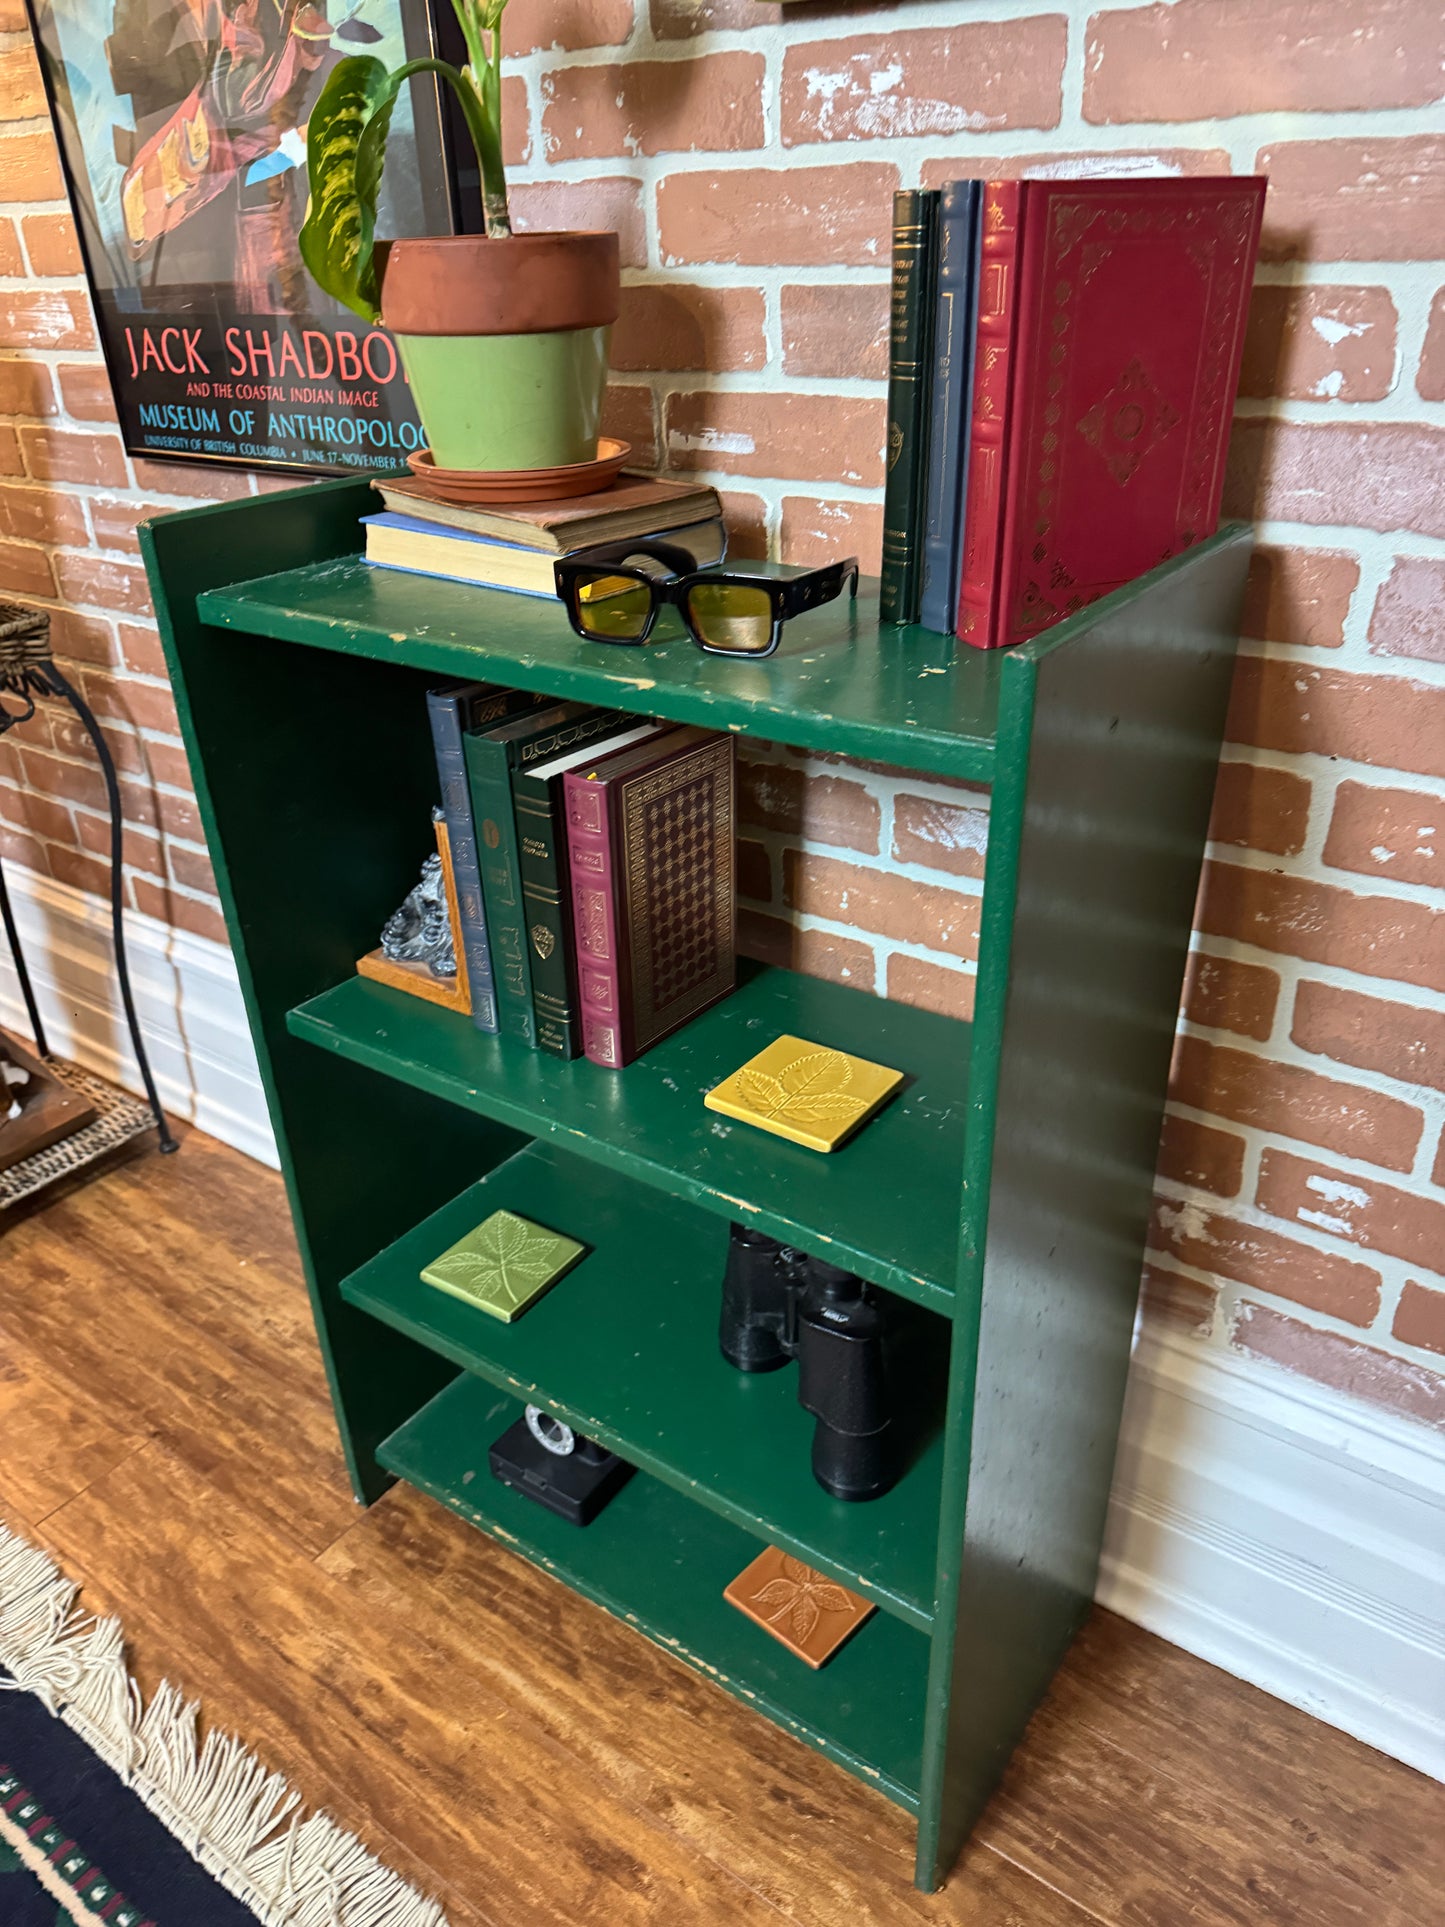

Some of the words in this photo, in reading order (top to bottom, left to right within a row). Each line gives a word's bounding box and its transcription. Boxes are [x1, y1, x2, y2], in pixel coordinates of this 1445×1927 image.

[125, 327, 210, 378] JACK
[225, 327, 409, 384] SHADBO
[186, 382, 210, 397] AND
[212, 383, 233, 399] THE
[235, 384, 286, 402] COASTAL
[290, 387, 334, 405] INDIAN
[338, 391, 379, 408] IMAGE
[139, 403, 220, 433] MUSEUM
[229, 409, 255, 435] OF
[144, 434, 189, 449] UNIVERSITY
[190, 438, 202, 450] OF
[203, 439, 236, 454] BRITISH
[240, 442, 287, 458] COLUMBIA
[302, 449, 325, 462] JUNE
[327, 451, 397, 470] 17-NOVEMBER
